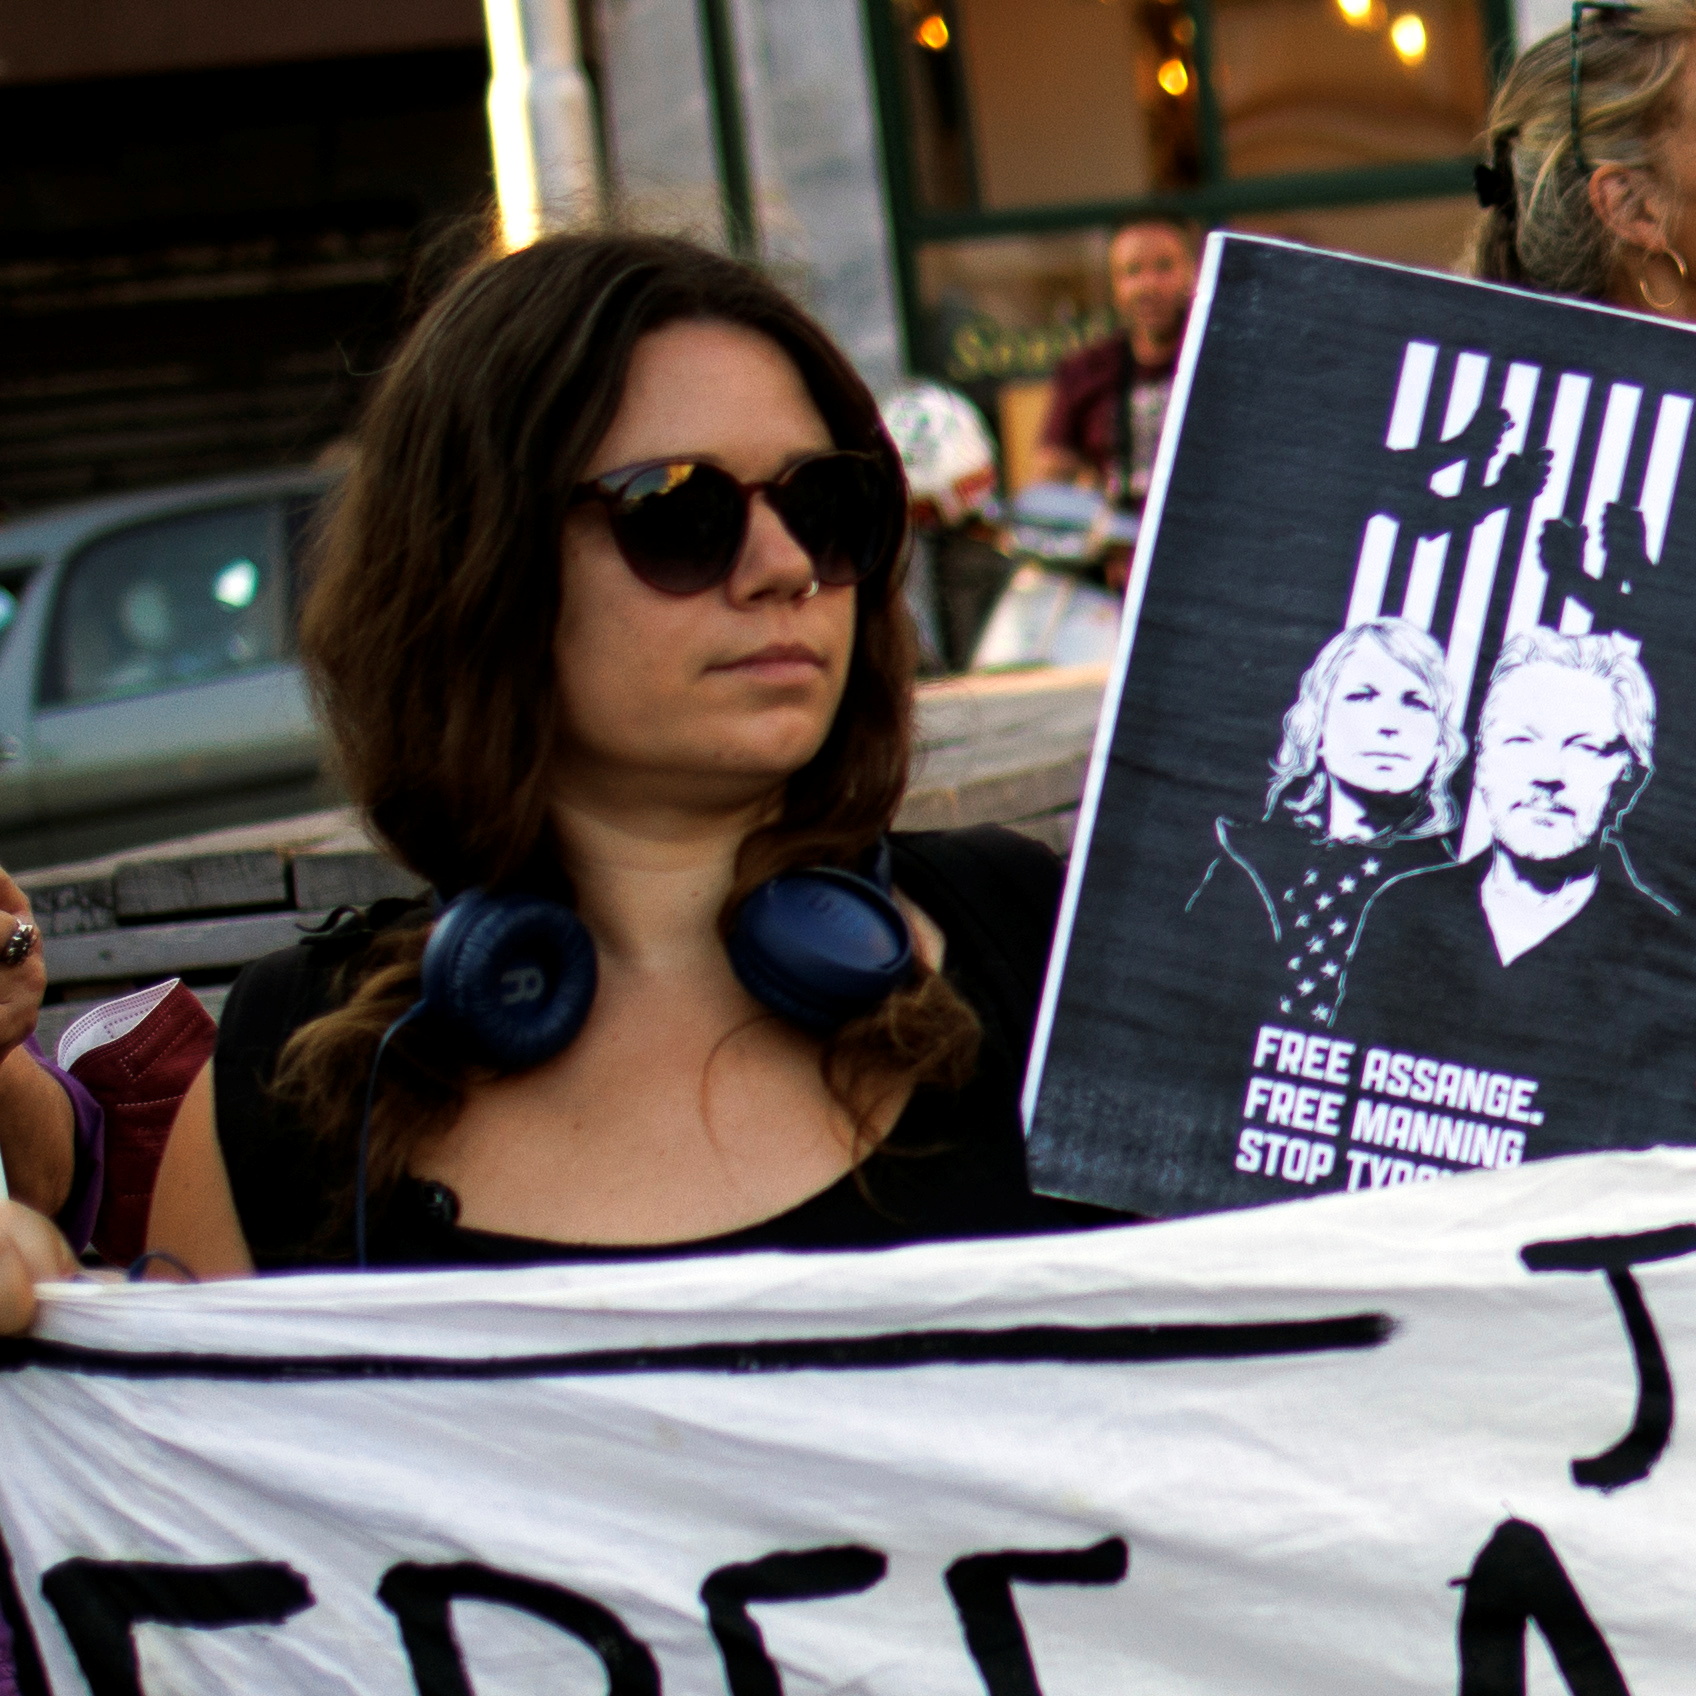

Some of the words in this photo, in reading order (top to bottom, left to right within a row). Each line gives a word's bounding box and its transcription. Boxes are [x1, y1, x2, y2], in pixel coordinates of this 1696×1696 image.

[1252, 1025, 1356, 1085] FREE
[1360, 1048, 1545, 1126] ASSANGE.
[1235, 1128, 1336, 1185] STOP
[1243, 1077, 1347, 1136] FREE
[1350, 1099, 1527, 1170] MANNING
